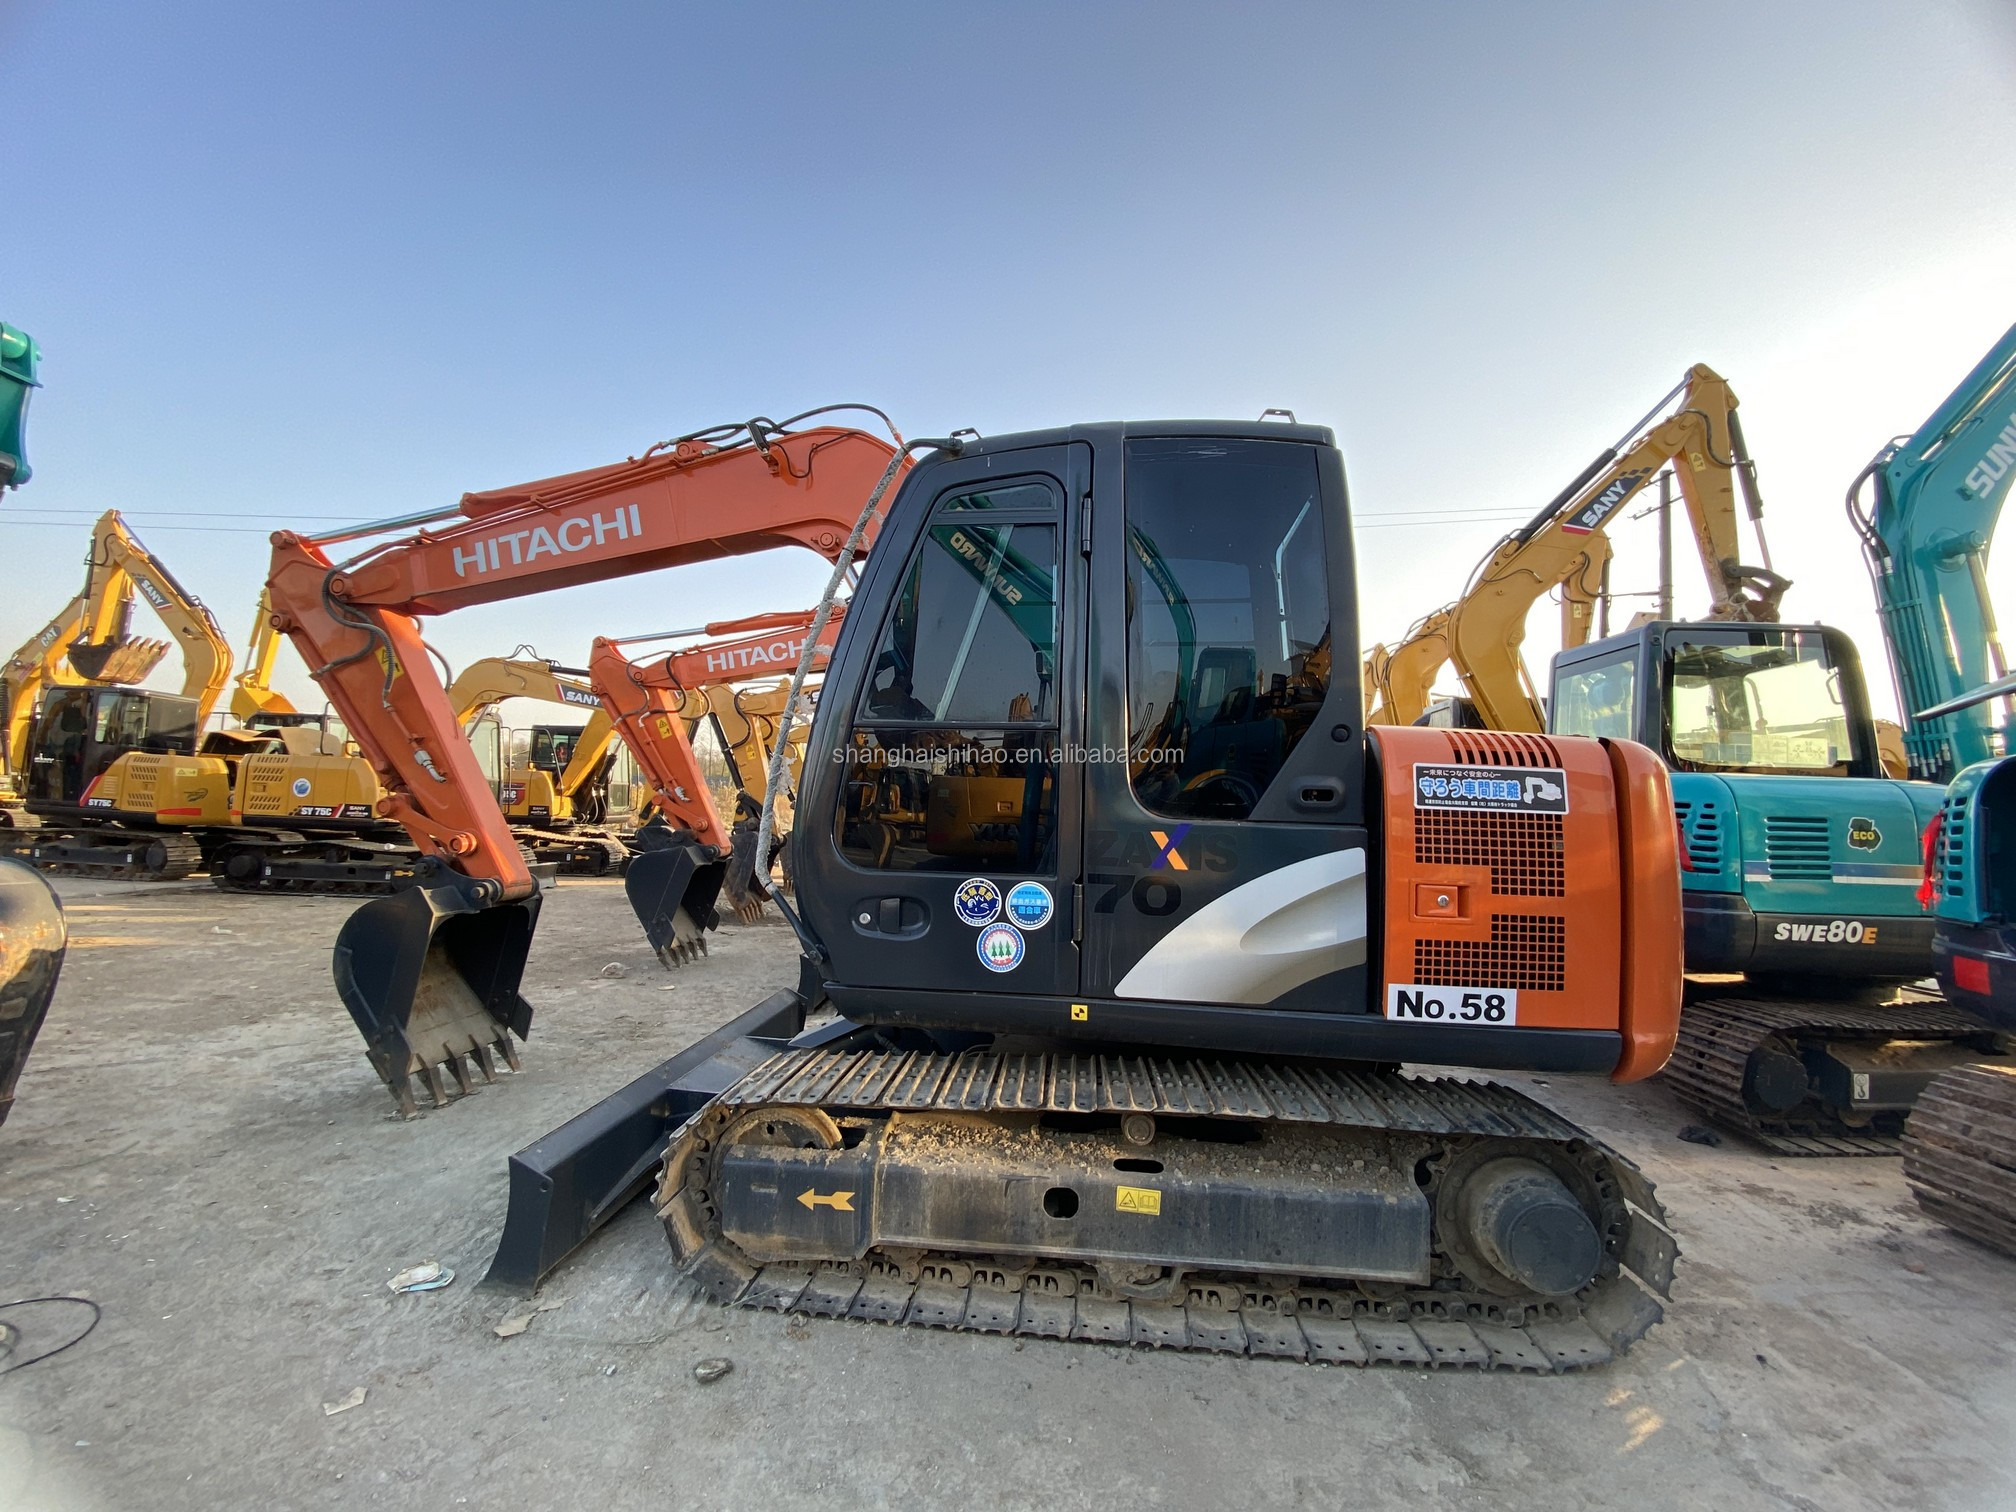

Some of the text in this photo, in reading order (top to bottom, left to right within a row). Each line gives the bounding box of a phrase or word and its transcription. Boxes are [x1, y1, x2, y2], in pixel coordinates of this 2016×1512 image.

[1581, 480, 1626, 527] SANY
[453, 504, 642, 577] HITACHI
[141, 579, 164, 604] SANY
[706, 639, 808, 673] HITACH
[565, 691, 600, 705] SANY
[1419, 777, 1521, 800] 守ろう車間距離
[300, 807, 333, 816] SY 75C
[1087, 823, 1239, 873] ZAXIS
[1853, 831, 1876, 841] ECO
[1087, 873, 1182, 917] 70
[1774, 920, 1878, 945] SWE80E
[1396, 990, 1506, 1022] No.58
